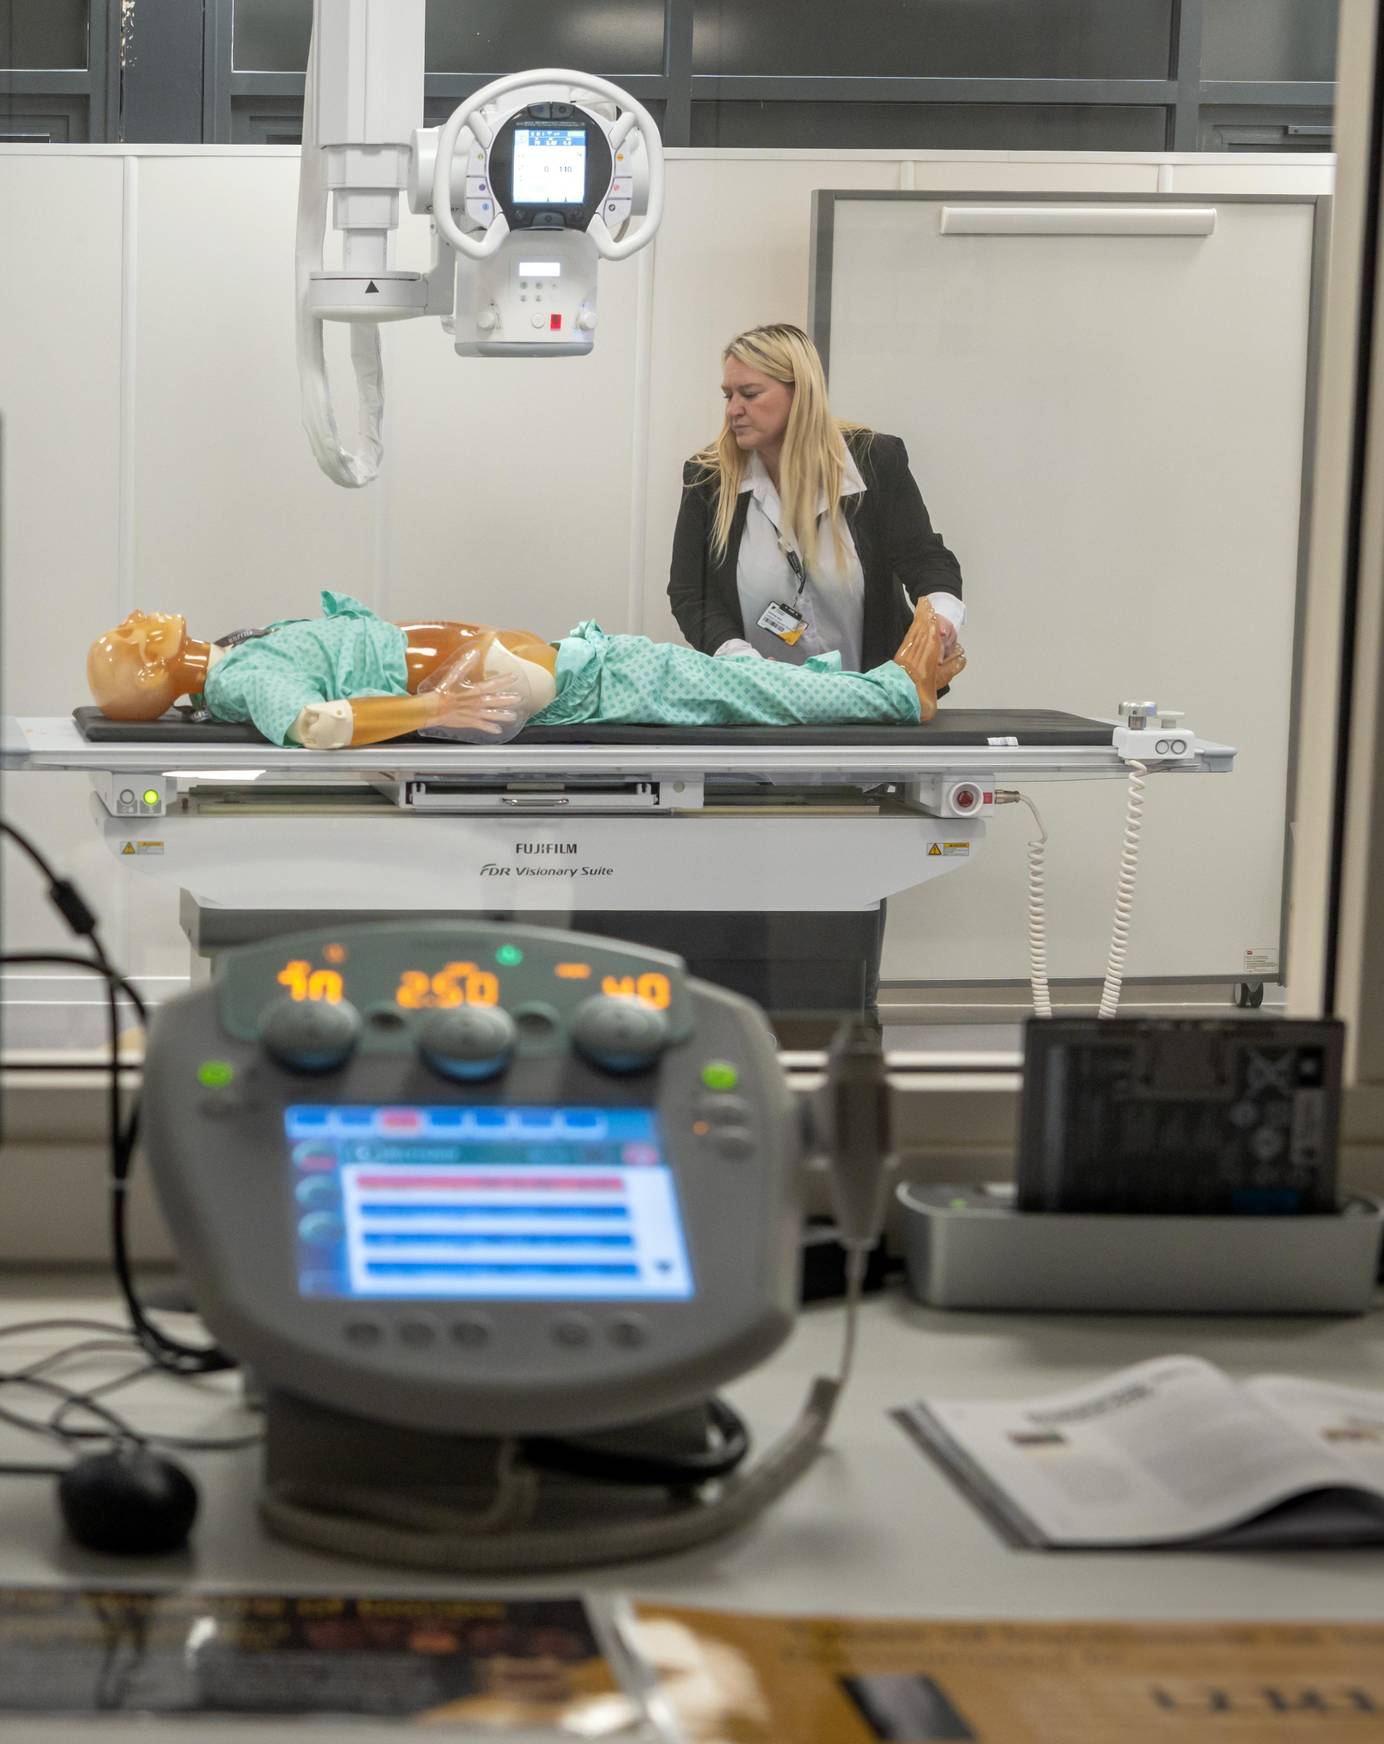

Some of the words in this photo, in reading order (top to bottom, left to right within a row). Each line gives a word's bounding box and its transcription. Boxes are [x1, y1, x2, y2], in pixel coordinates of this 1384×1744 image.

[515, 843, 578, 854] FUJIFILM
[479, 863, 511, 876] FDR
[515, 867, 578, 878] Visionary
[580, 867, 614, 876] Suite
